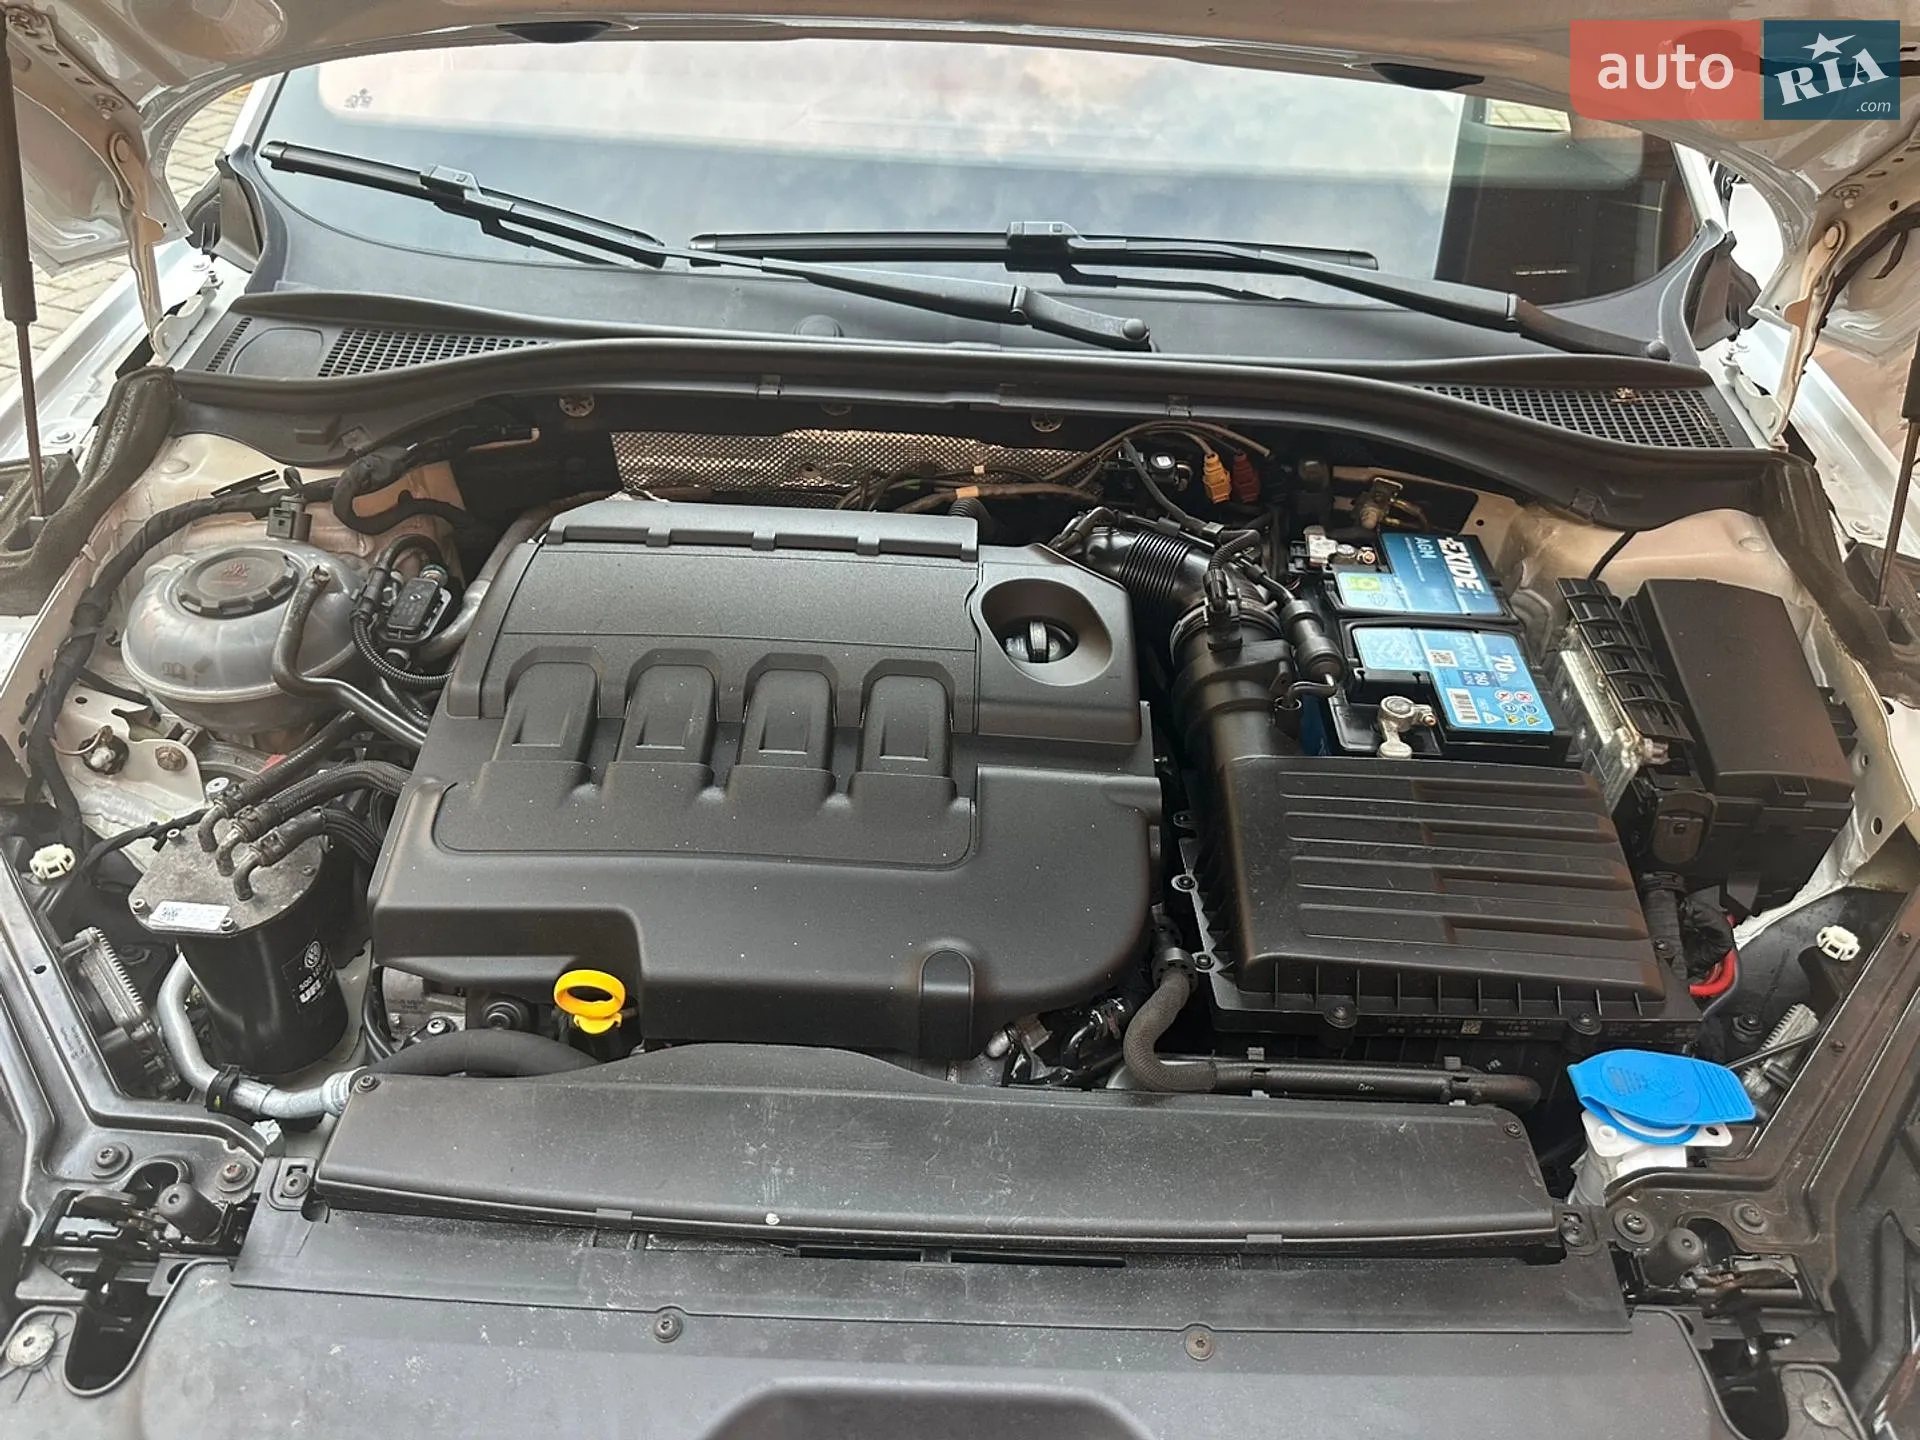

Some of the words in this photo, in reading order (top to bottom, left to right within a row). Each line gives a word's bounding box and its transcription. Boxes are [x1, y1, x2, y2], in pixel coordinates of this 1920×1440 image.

[1414, 536, 1437, 560] AGM
[1437, 536, 1485, 594] EXIDE
[1454, 634, 1482, 669] EK700
[1491, 653, 1517, 675] 70
